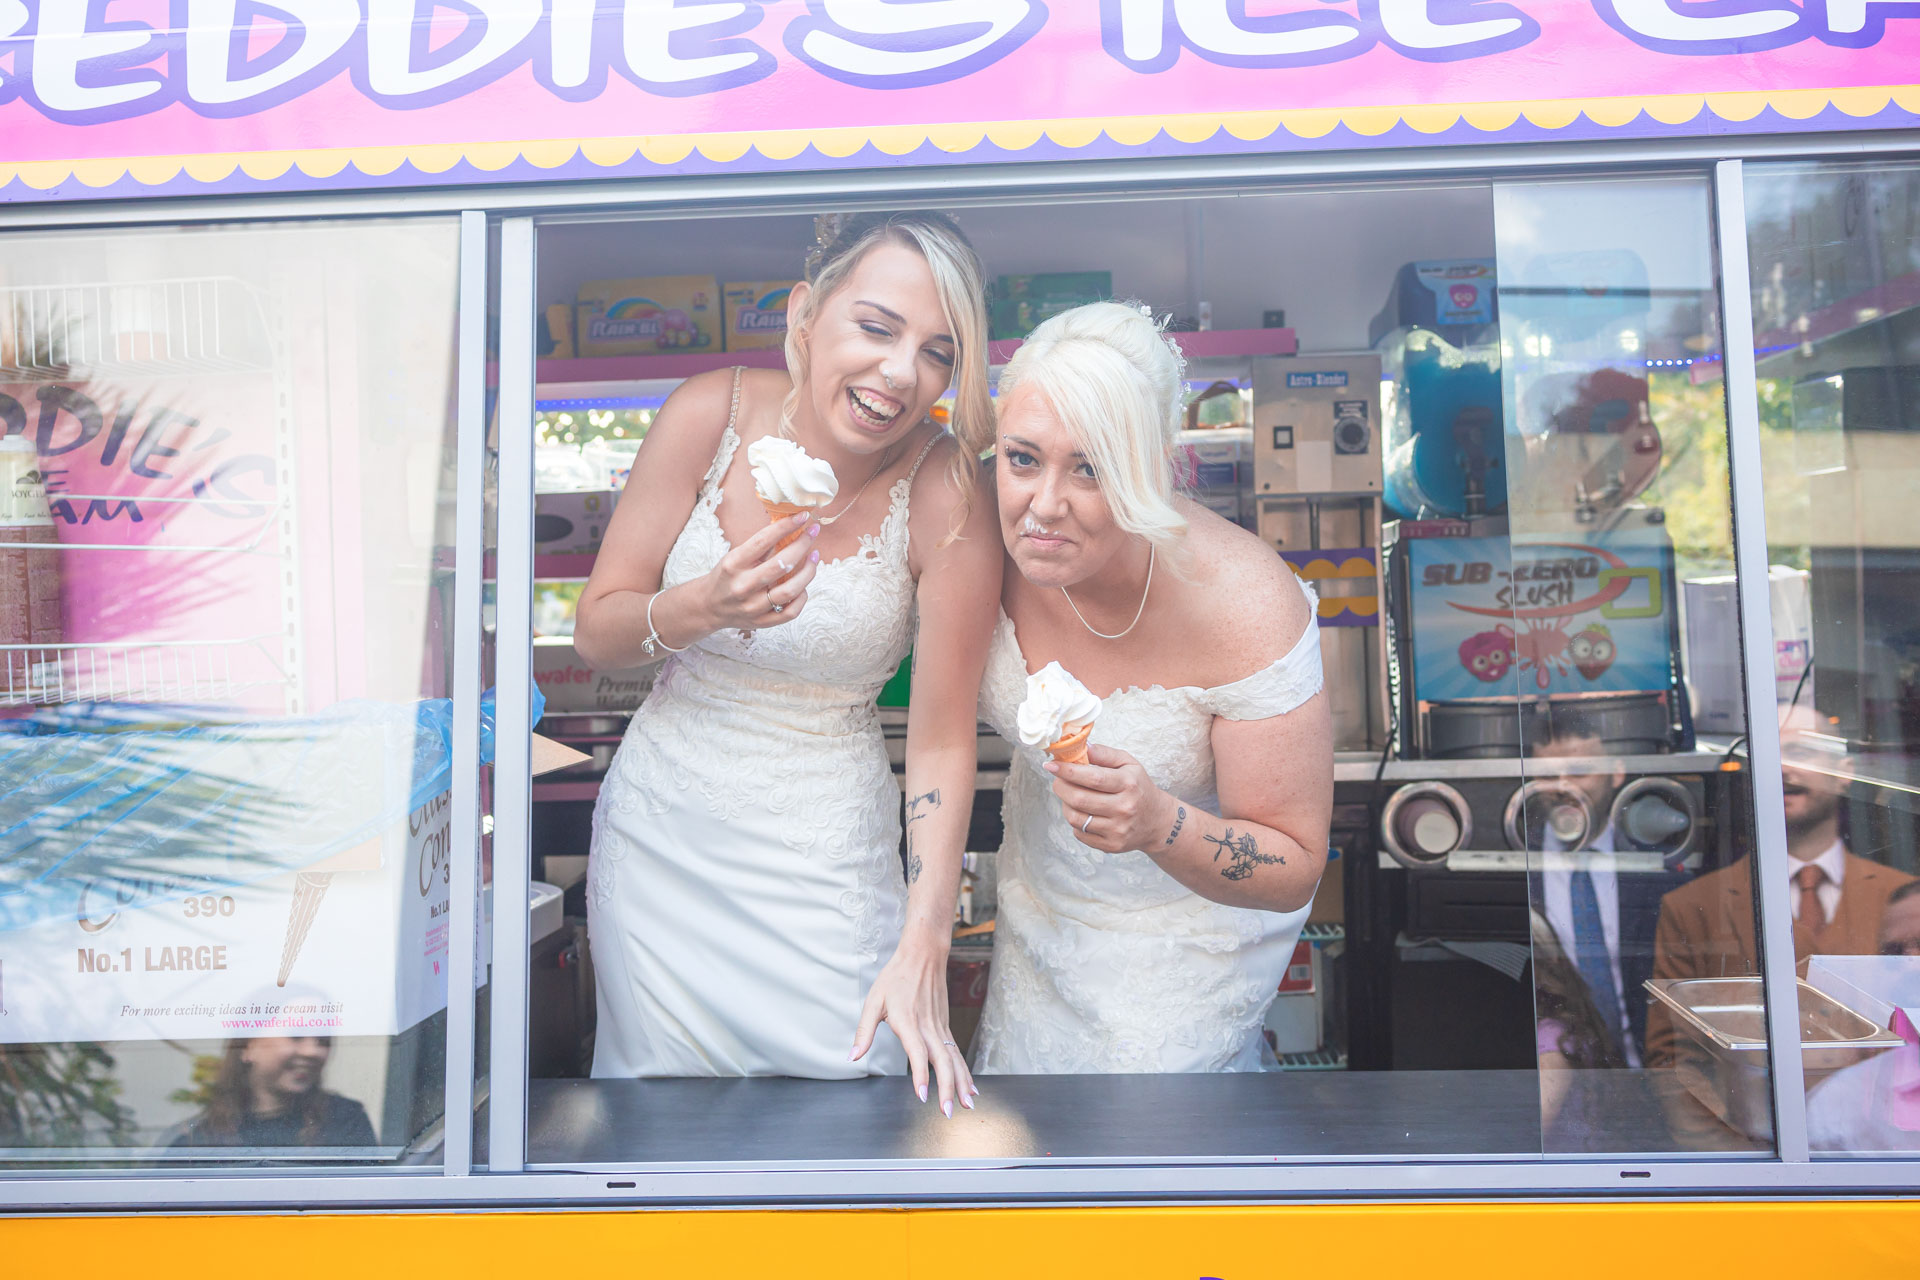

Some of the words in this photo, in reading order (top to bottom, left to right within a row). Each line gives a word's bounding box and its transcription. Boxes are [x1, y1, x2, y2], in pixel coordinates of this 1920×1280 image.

[1496, 579, 1574, 609] SLUSH
[183, 895, 236, 918] 390
[78, 948, 132, 973] No.1
[145, 945, 228, 972] LARGE
[120, 1005, 141, 1017] For
[143, 1006, 170, 1016] more
[174, 1003, 216, 1018] exciting
[219, 1003, 247, 1015] ideas
[249, 1003, 261, 1015] in
[265, 1002, 280, 1014] ice
[283, 1005, 317, 1014] cream
[321, 1001, 344, 1013] visit
[221, 1015, 343, 1029] www.waferltd.co.uk
